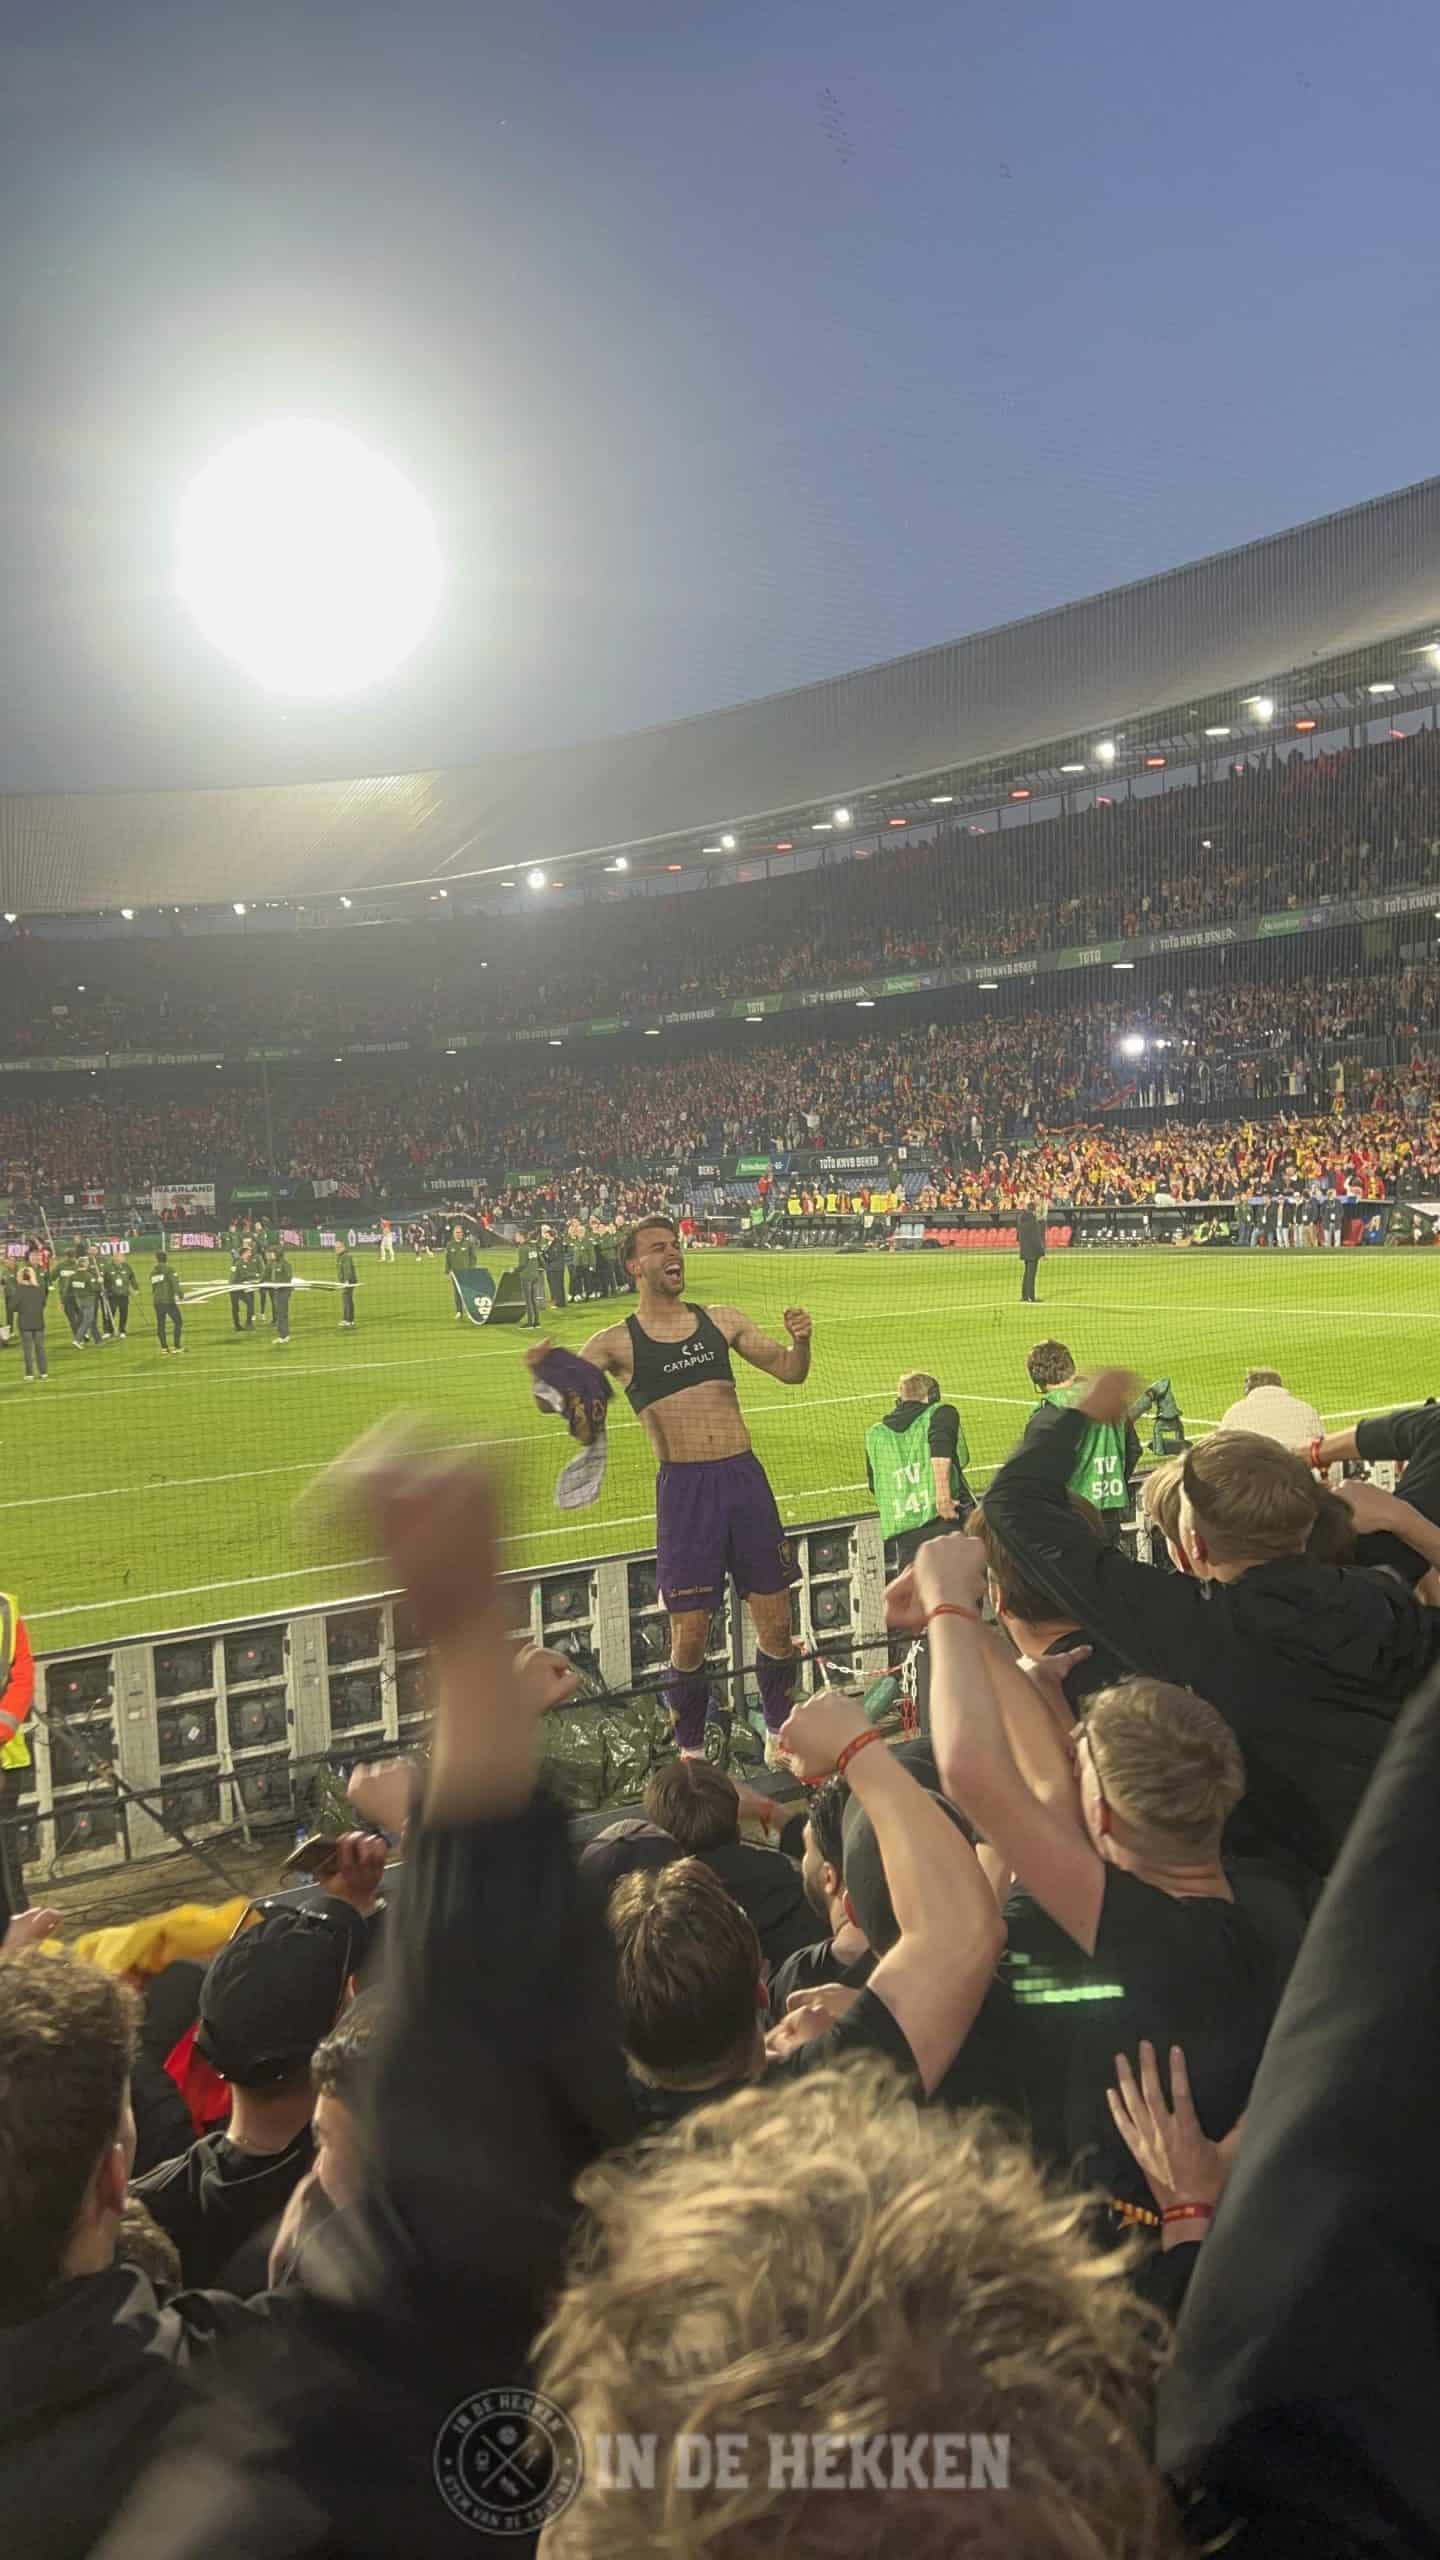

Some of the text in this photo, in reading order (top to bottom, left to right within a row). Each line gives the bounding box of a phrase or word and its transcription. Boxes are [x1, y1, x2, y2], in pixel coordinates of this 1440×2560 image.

[1384, 896, 1408, 912] TOTO
[663, 1351, 715, 1373] CATAPULT
[895, 1462, 921, 1490] TV
[1093, 1455, 1118, 1475] TV
[1091, 1478, 1123, 1500] 520
